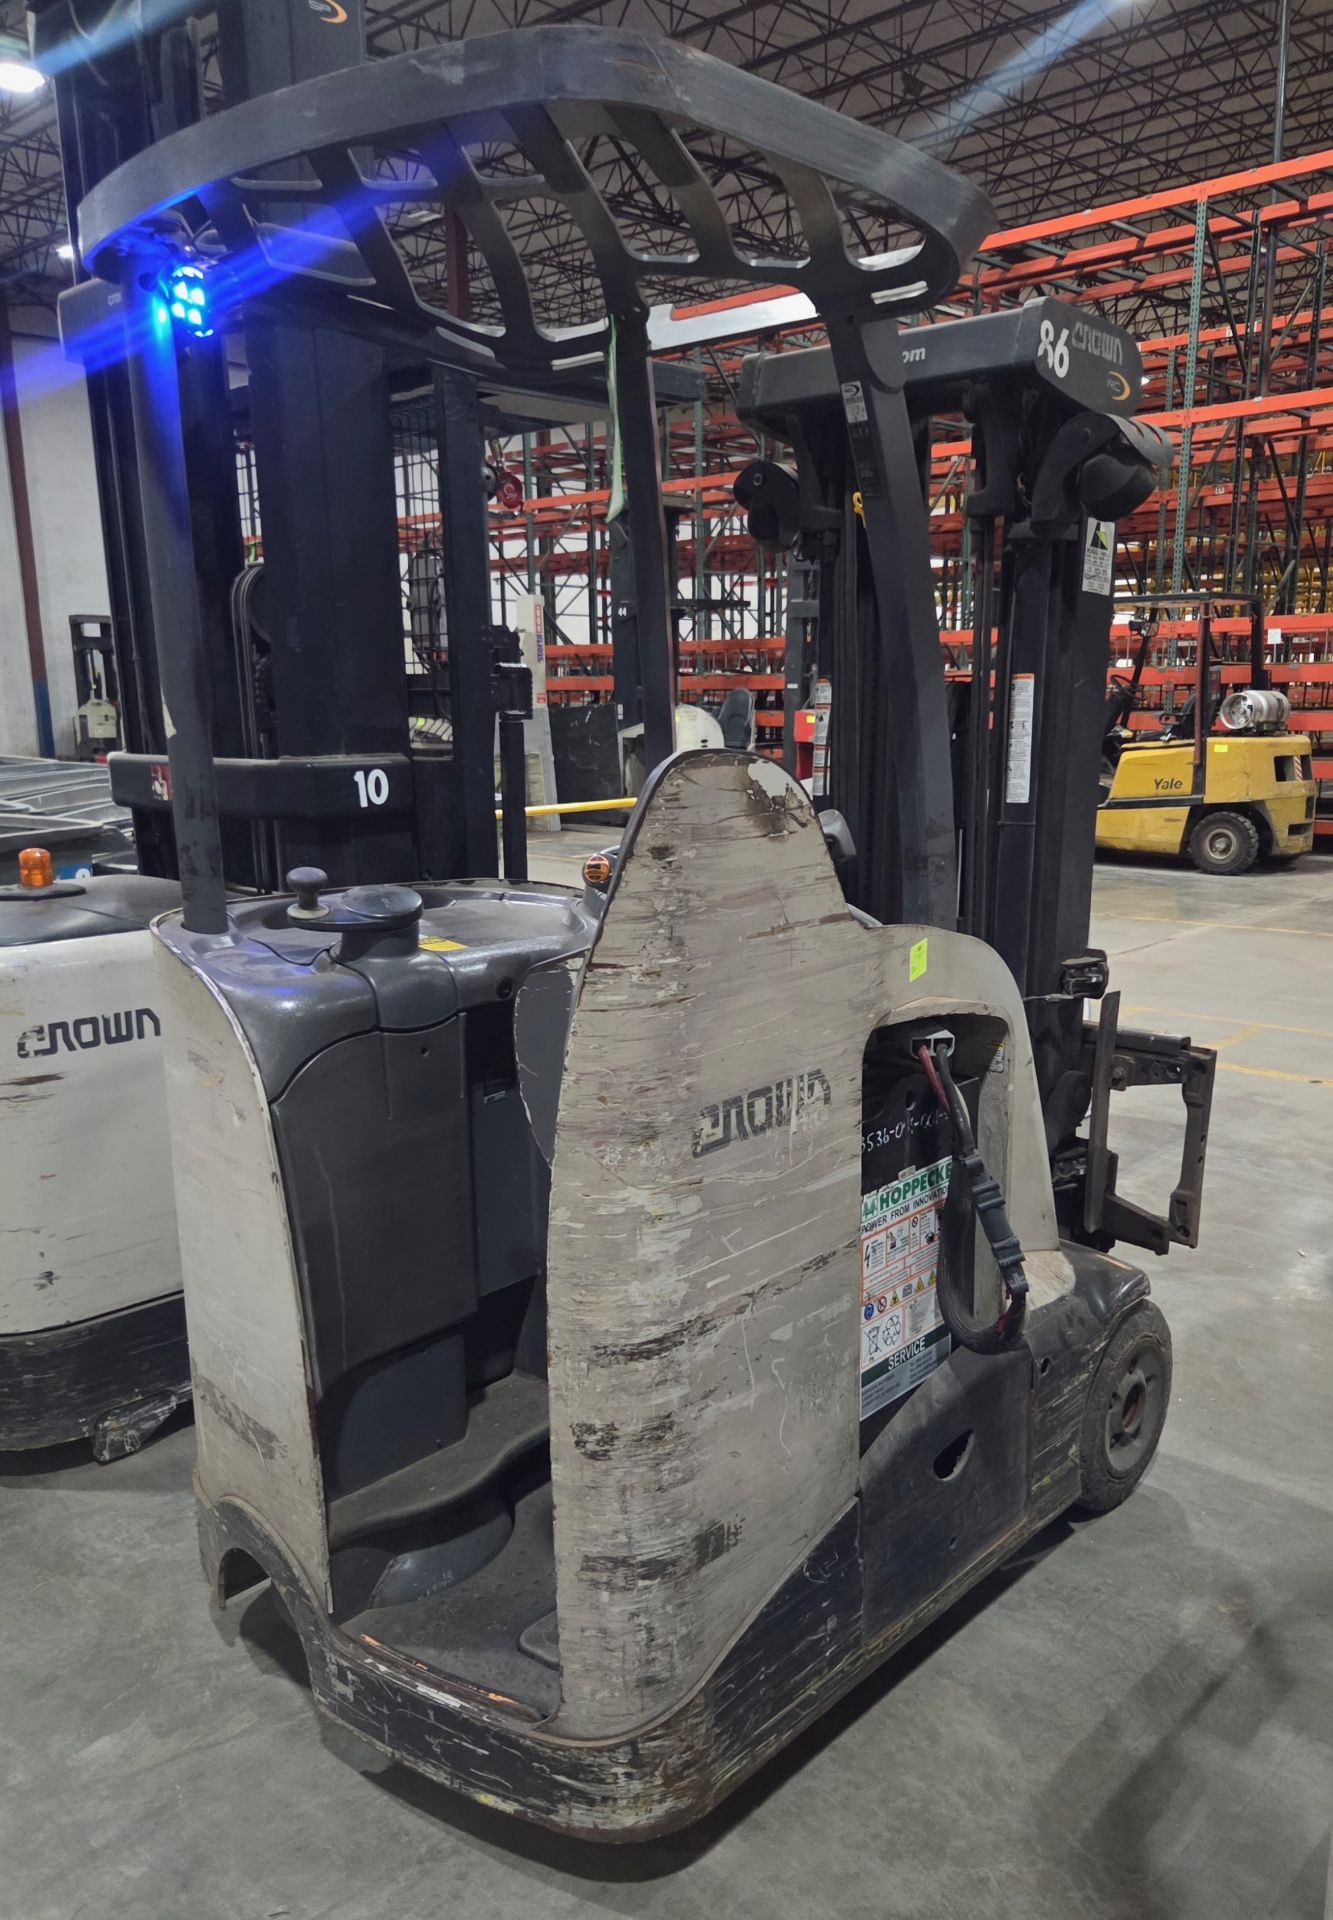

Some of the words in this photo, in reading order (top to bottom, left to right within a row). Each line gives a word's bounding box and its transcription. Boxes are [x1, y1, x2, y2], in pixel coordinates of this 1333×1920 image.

[1037, 320, 1070, 378] 86
[1071, 321, 1123, 366] CROWN
[618, 606, 627, 617] 44
[353, 768, 390, 808] 10
[1154, 777, 1183, 790] Yale
[16, 1007, 161, 1059] CROWN
[691, 1068, 831, 1159] CROWN
[862, 1214, 888, 1234] POWER
[890, 1203, 910, 1221] FROM
[912, 1185, 948, 1209] INNOVATIO
[887, 1336, 926, 1371] SERVICE
